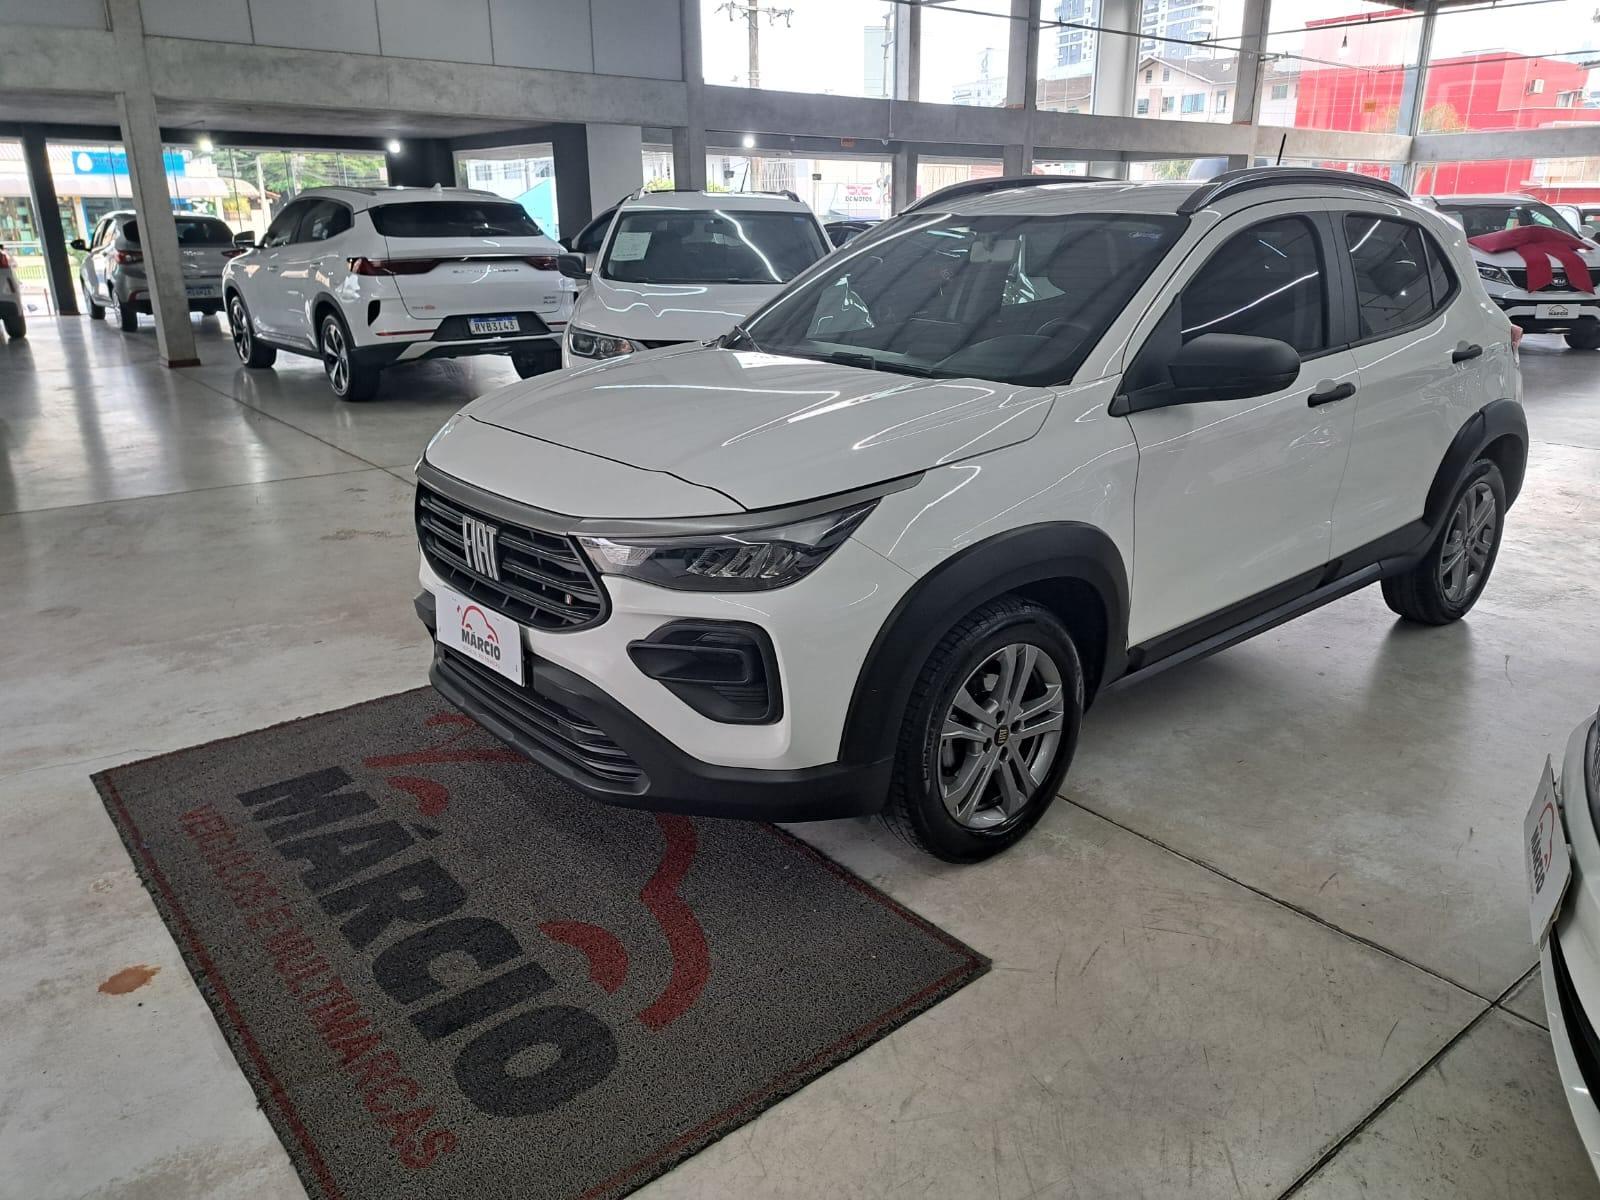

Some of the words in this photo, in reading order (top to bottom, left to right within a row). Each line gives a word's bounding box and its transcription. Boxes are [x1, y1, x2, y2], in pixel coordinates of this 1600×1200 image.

[474, 320, 515, 333] RYB3143
[462, 515, 499, 582] FIAT
[461, 628, 501, 661] MÁRCIO
[236, 766, 619, 1118] MÁRCIO
